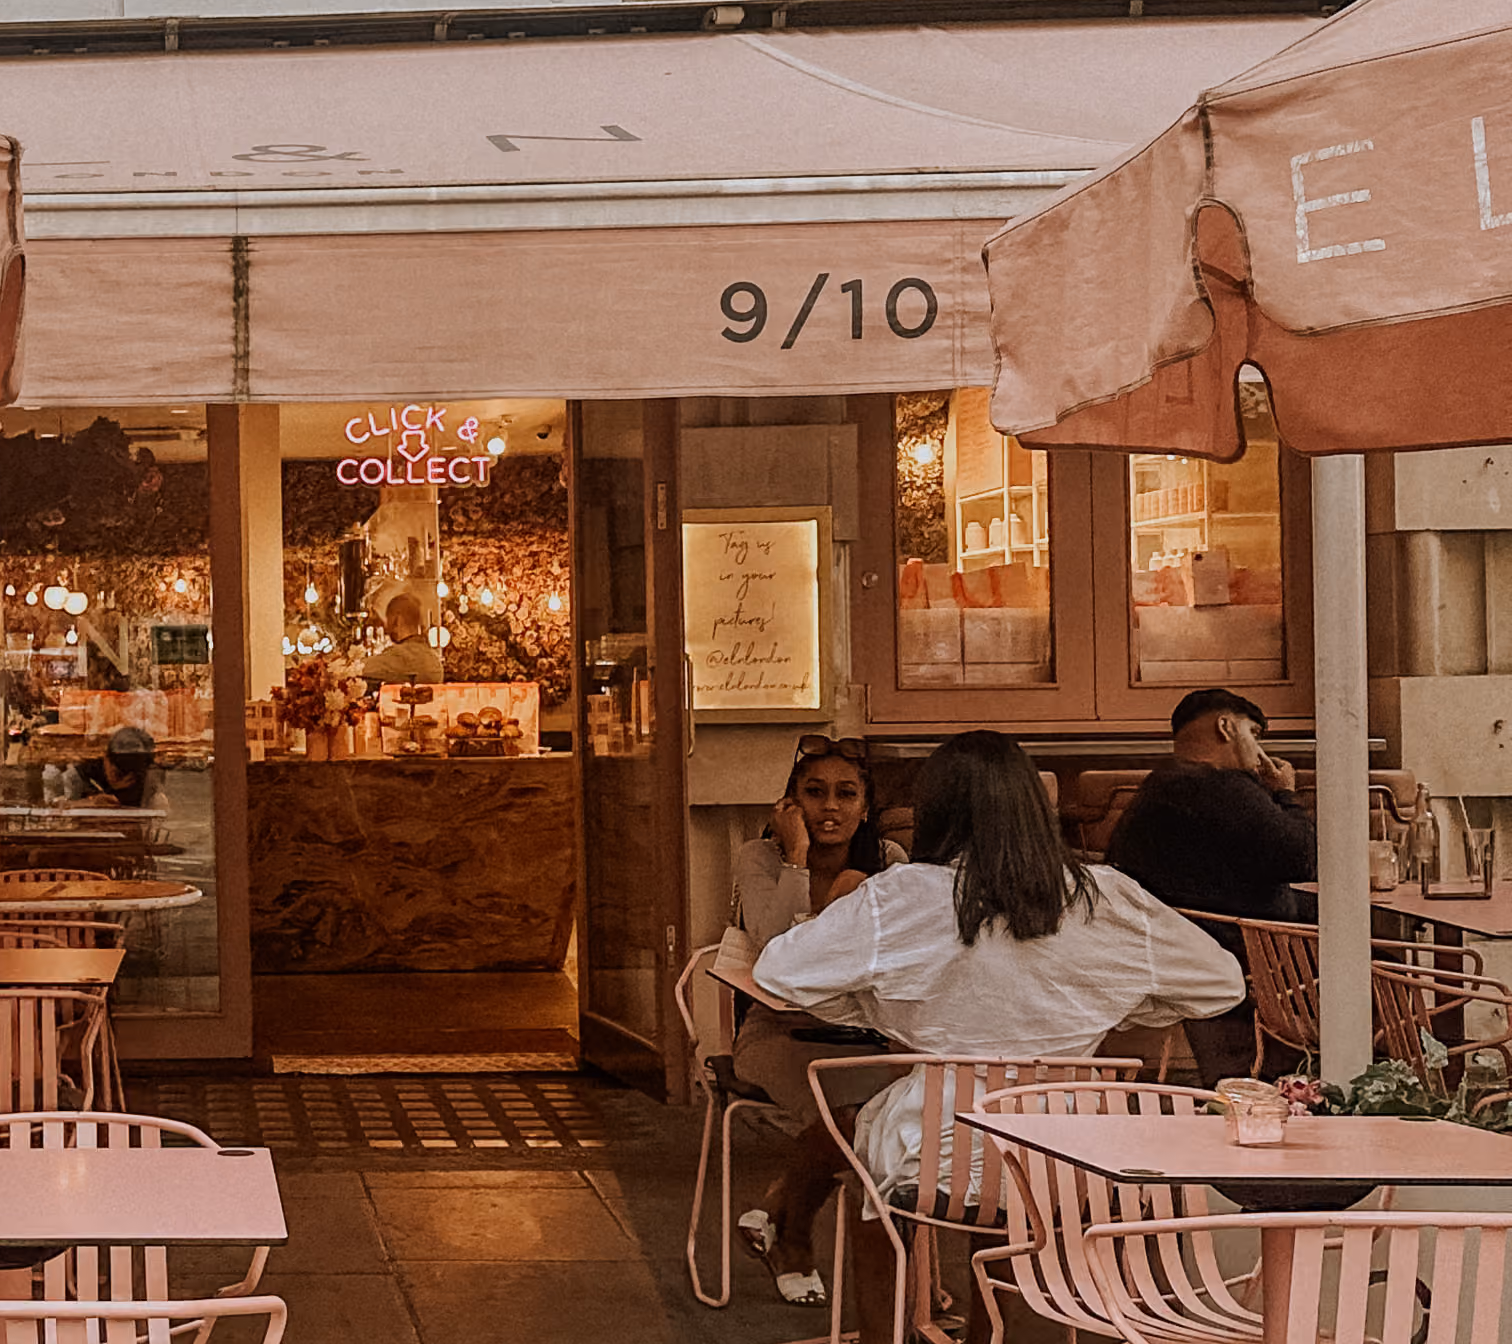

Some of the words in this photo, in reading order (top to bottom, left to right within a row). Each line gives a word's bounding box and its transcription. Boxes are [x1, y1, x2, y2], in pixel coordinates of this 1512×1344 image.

[23, 168, 405, 180] ONDON
[719, 272, 939, 350] 9/10
[345, 404, 447, 444] CLICK
[457, 416, 479, 444] &
[336, 456, 491, 485] COLLECT
[718, 530, 748, 565] Tag
[756, 540, 776, 555] us
[719, 573, 734, 581] in
[736, 571, 776, 601] your
